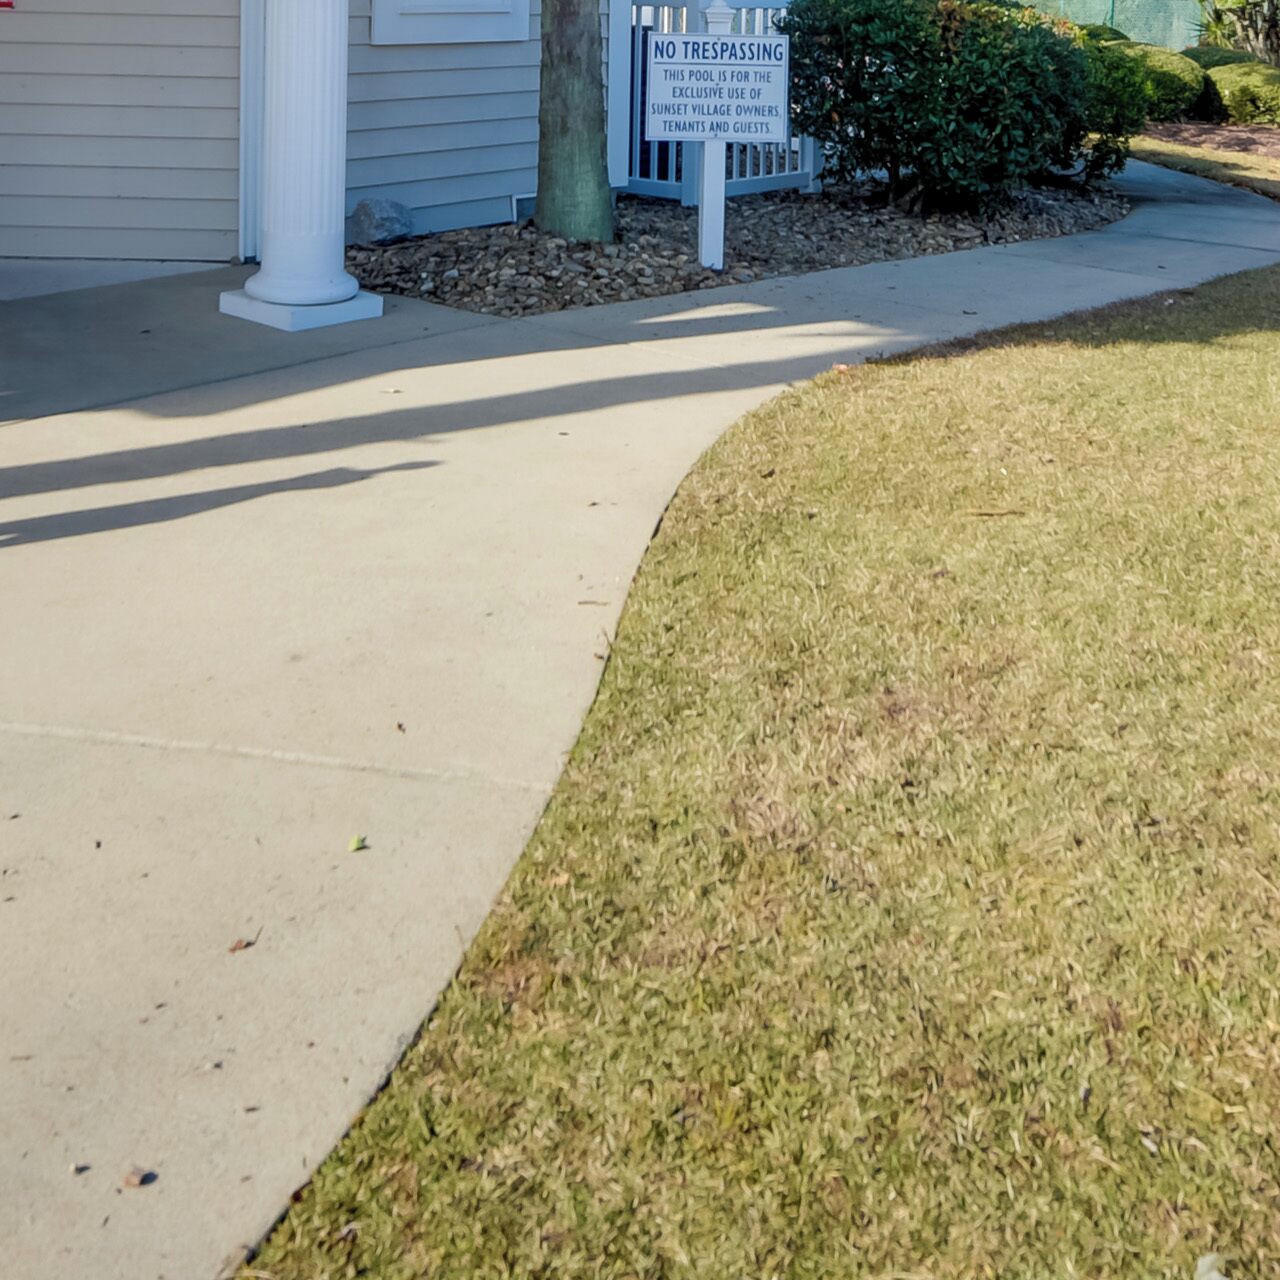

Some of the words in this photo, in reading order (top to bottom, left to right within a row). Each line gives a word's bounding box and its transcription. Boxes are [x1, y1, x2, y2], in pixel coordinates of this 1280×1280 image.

[654, 41, 676, 58] NO
[683, 41, 783, 61] TRESPASSING
[663, 69, 684, 81] THIS
[689, 70, 714, 82] POOL
[718, 71, 727, 82] IS
[731, 71, 749, 82] FOR
[754, 71, 771, 83] THE
[672, 87, 723, 99] EXCLUSIVE
[728, 88, 745, 99] USE
[750, 88, 762, 100] OF
[652, 103, 688, 115] SUNSET
[692, 104, 731, 116] VILLAGE
[736, 105, 781, 118] OWNERS,
[663, 120, 705, 132] TENANTS
[709, 121, 729, 133] AND
[733, 122, 772, 134] GUESTS.
